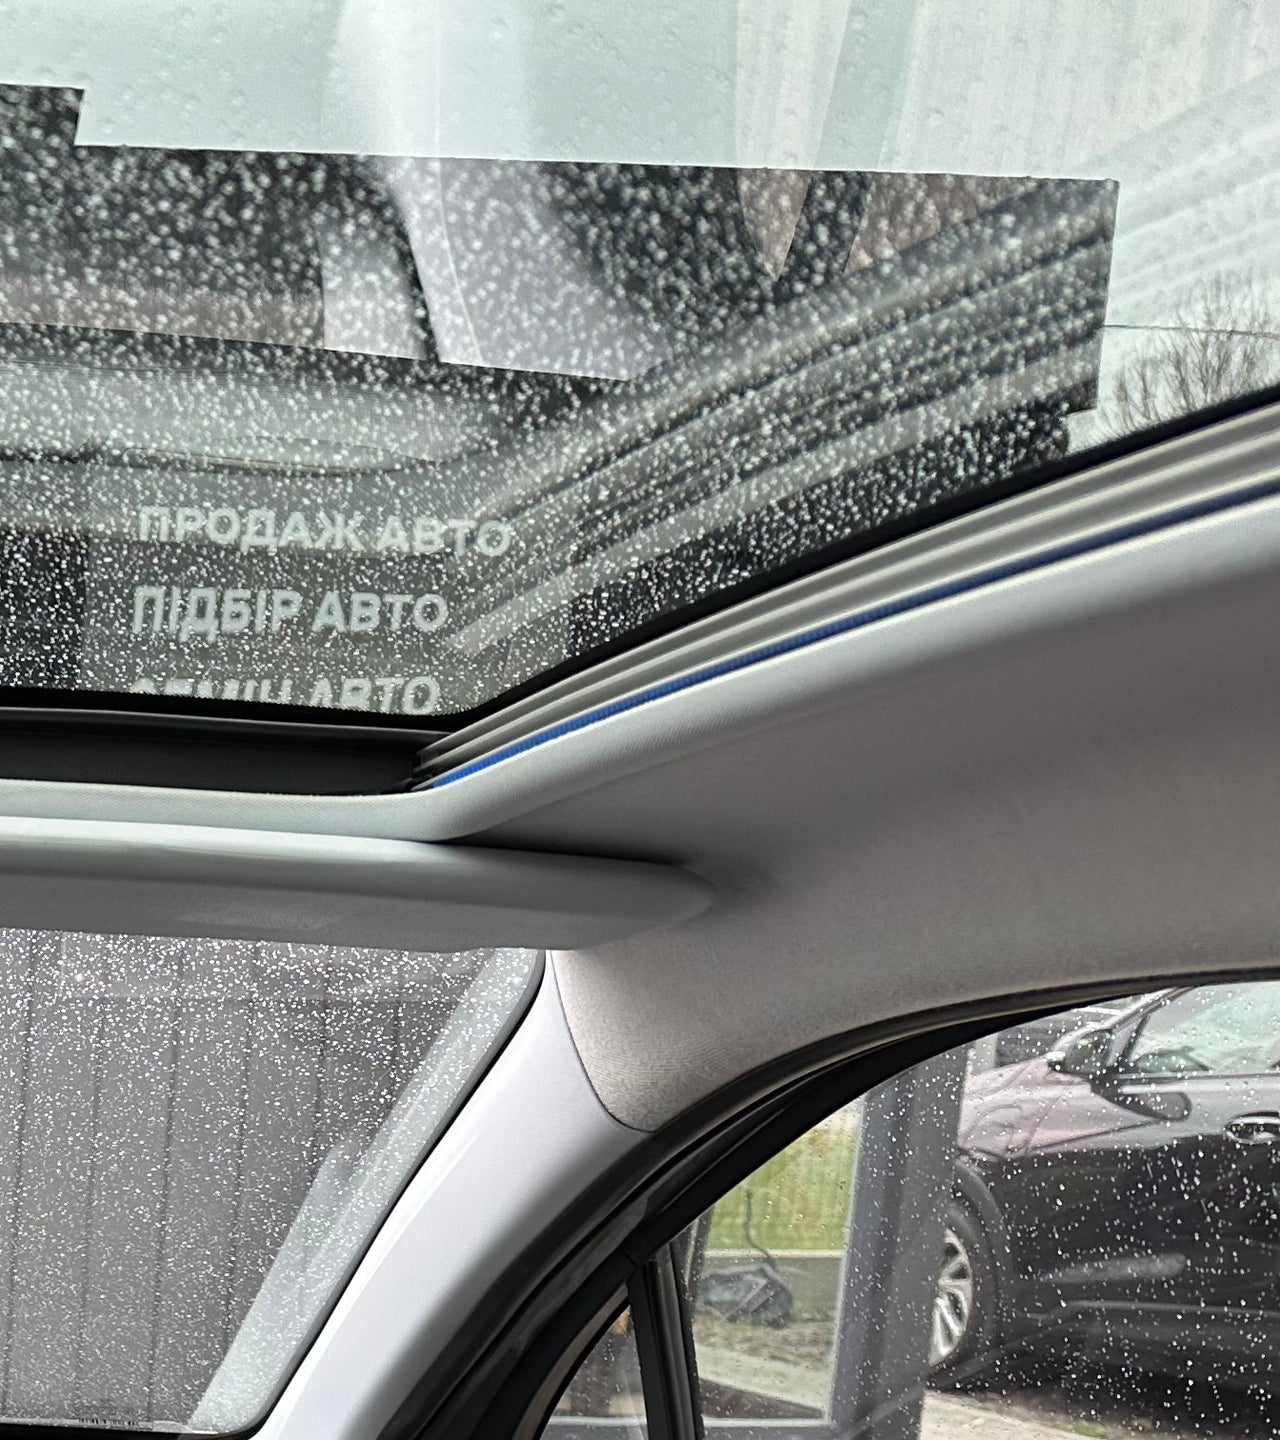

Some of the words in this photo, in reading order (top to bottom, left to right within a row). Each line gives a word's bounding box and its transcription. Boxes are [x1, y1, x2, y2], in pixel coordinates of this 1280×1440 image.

[139, 506, 365, 555] ПРОДАЖ
[375, 518, 512, 557] АВТО
[133, 586, 304, 643] ПІДБІР
[312, 591, 449, 632] АВТО
